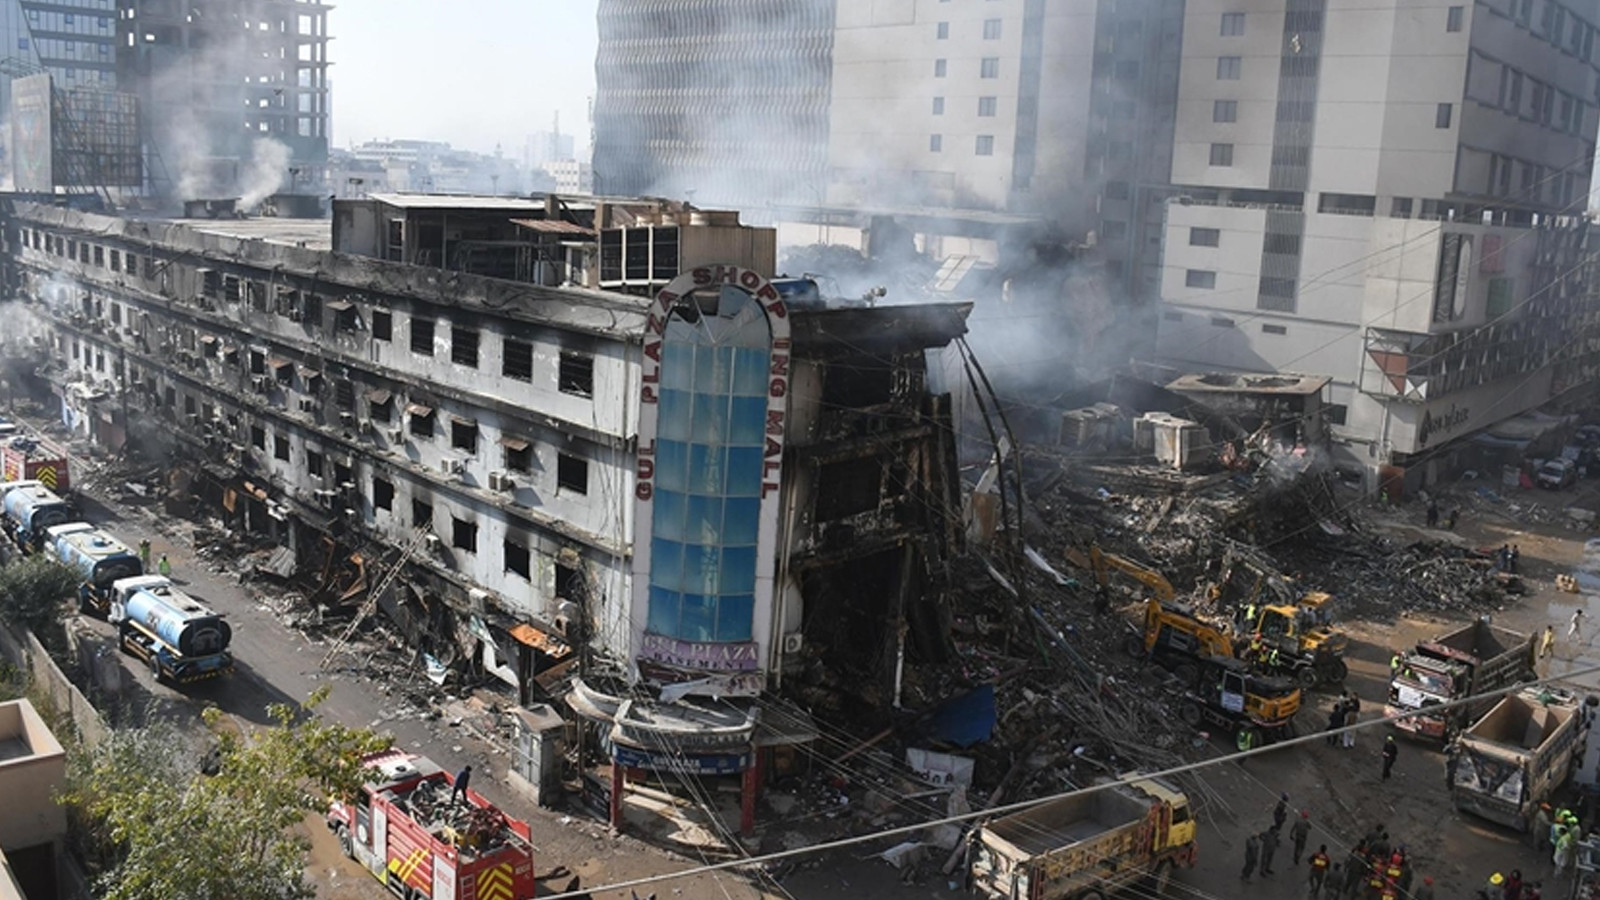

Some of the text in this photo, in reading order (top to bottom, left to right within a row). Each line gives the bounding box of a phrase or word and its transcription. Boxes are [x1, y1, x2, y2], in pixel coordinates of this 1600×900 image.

[641, 289, 679, 404] PLAZA
[635, 438, 655, 501] GUL
[761, 409, 785, 500] MALL
[653, 651, 745, 669] BASEMENT
[690, 643, 758, 660] PLAZA
